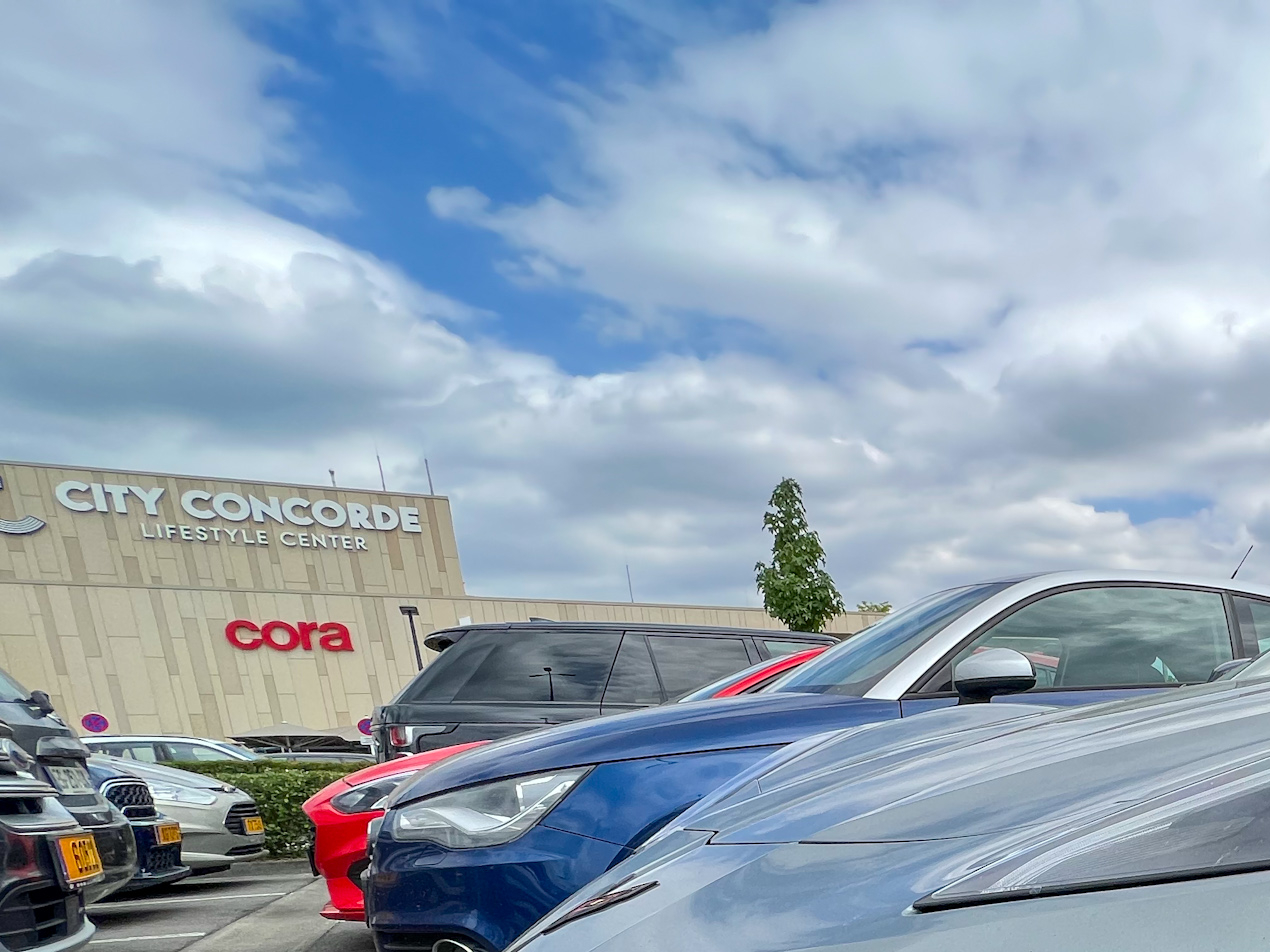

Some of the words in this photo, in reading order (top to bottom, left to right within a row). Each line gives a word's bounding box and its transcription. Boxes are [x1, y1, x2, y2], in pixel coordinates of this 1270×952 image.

[55, 480, 165, 516] CITY
[181, 490, 422, 533] CONCORDE
[140, 523, 268, 545] LIFESTYLE
[280, 532, 368, 551] CENTER
[225, 619, 354, 652] cora
